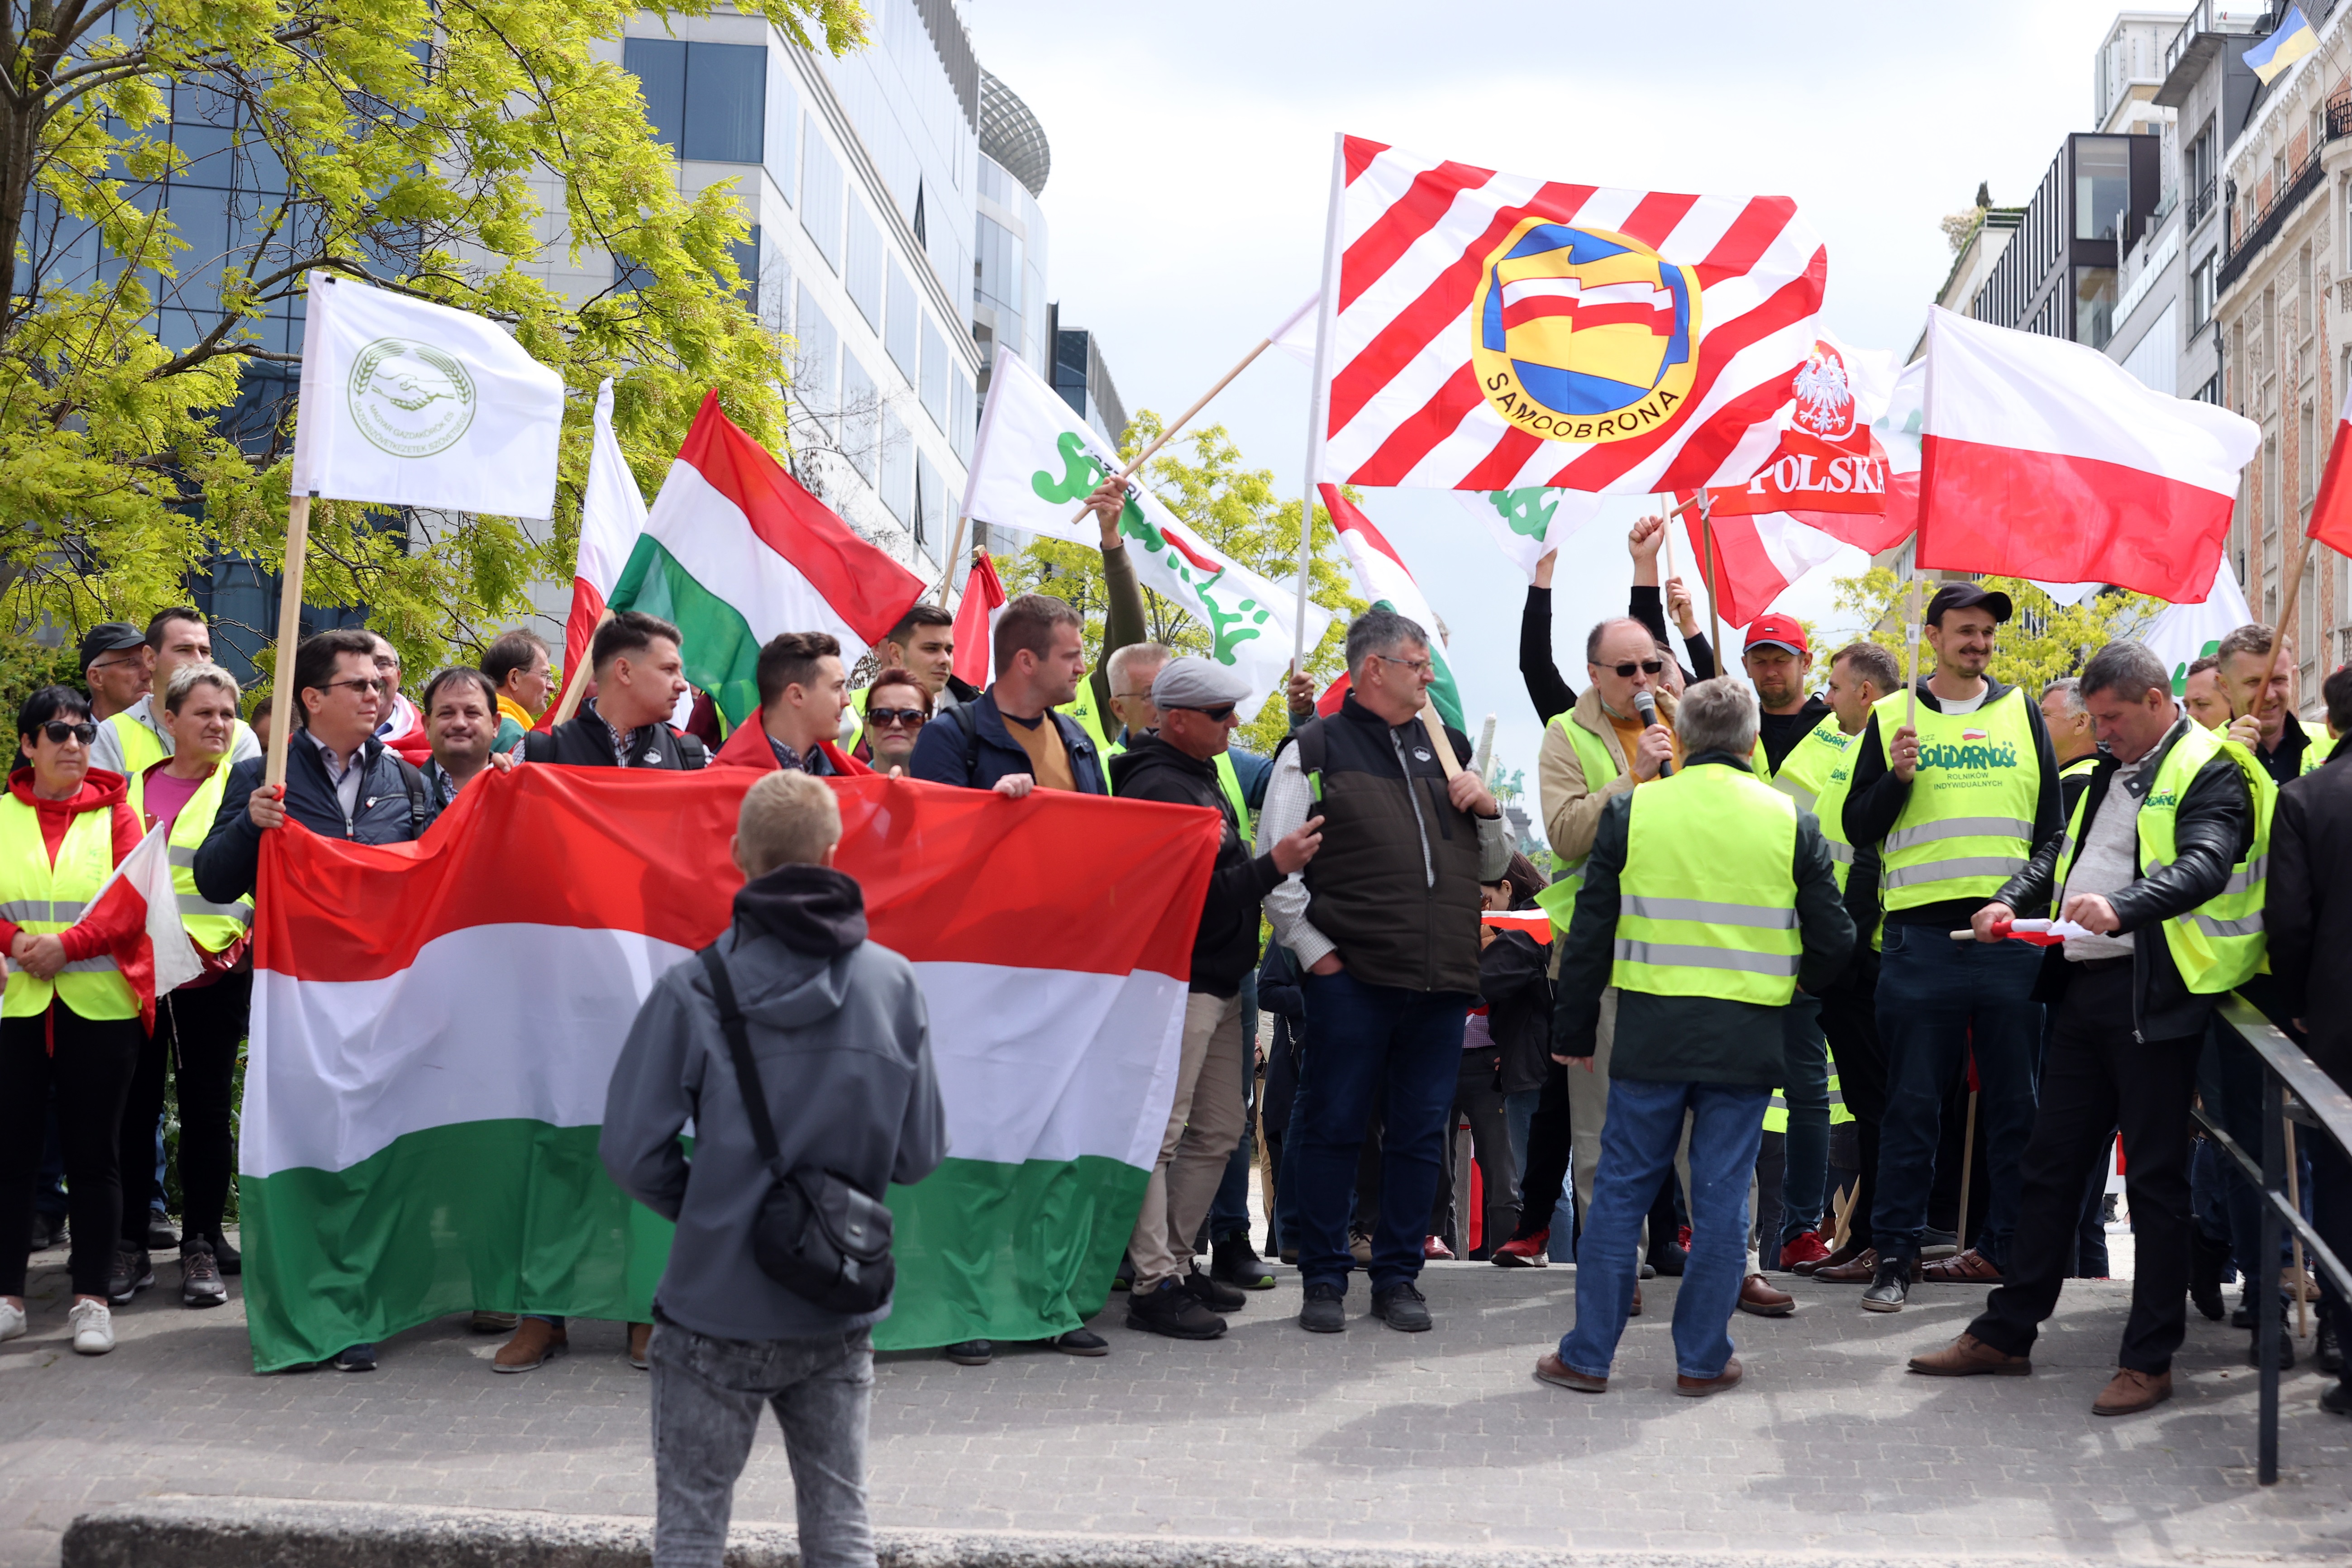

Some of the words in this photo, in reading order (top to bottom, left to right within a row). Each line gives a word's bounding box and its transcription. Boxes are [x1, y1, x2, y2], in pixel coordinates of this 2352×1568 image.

[1487, 372, 1679, 438] SAMOOBRONA
[354, 401, 427, 453] GAZDASZÖVETKEZETEK
[429, 411, 470, 450] SZÖVETSÉGE
[369, 404, 393, 433] MAGYAR
[393, 421, 447, 439] GAZDAKÖRÖK
[444, 410, 454, 422] ÉS
[1918, 734, 1935, 743] SZZ
[1934, 780, 2003, 790] INDYWIDUALNYCH
[1947, 772, 1989, 780] ROLNIKÓW
